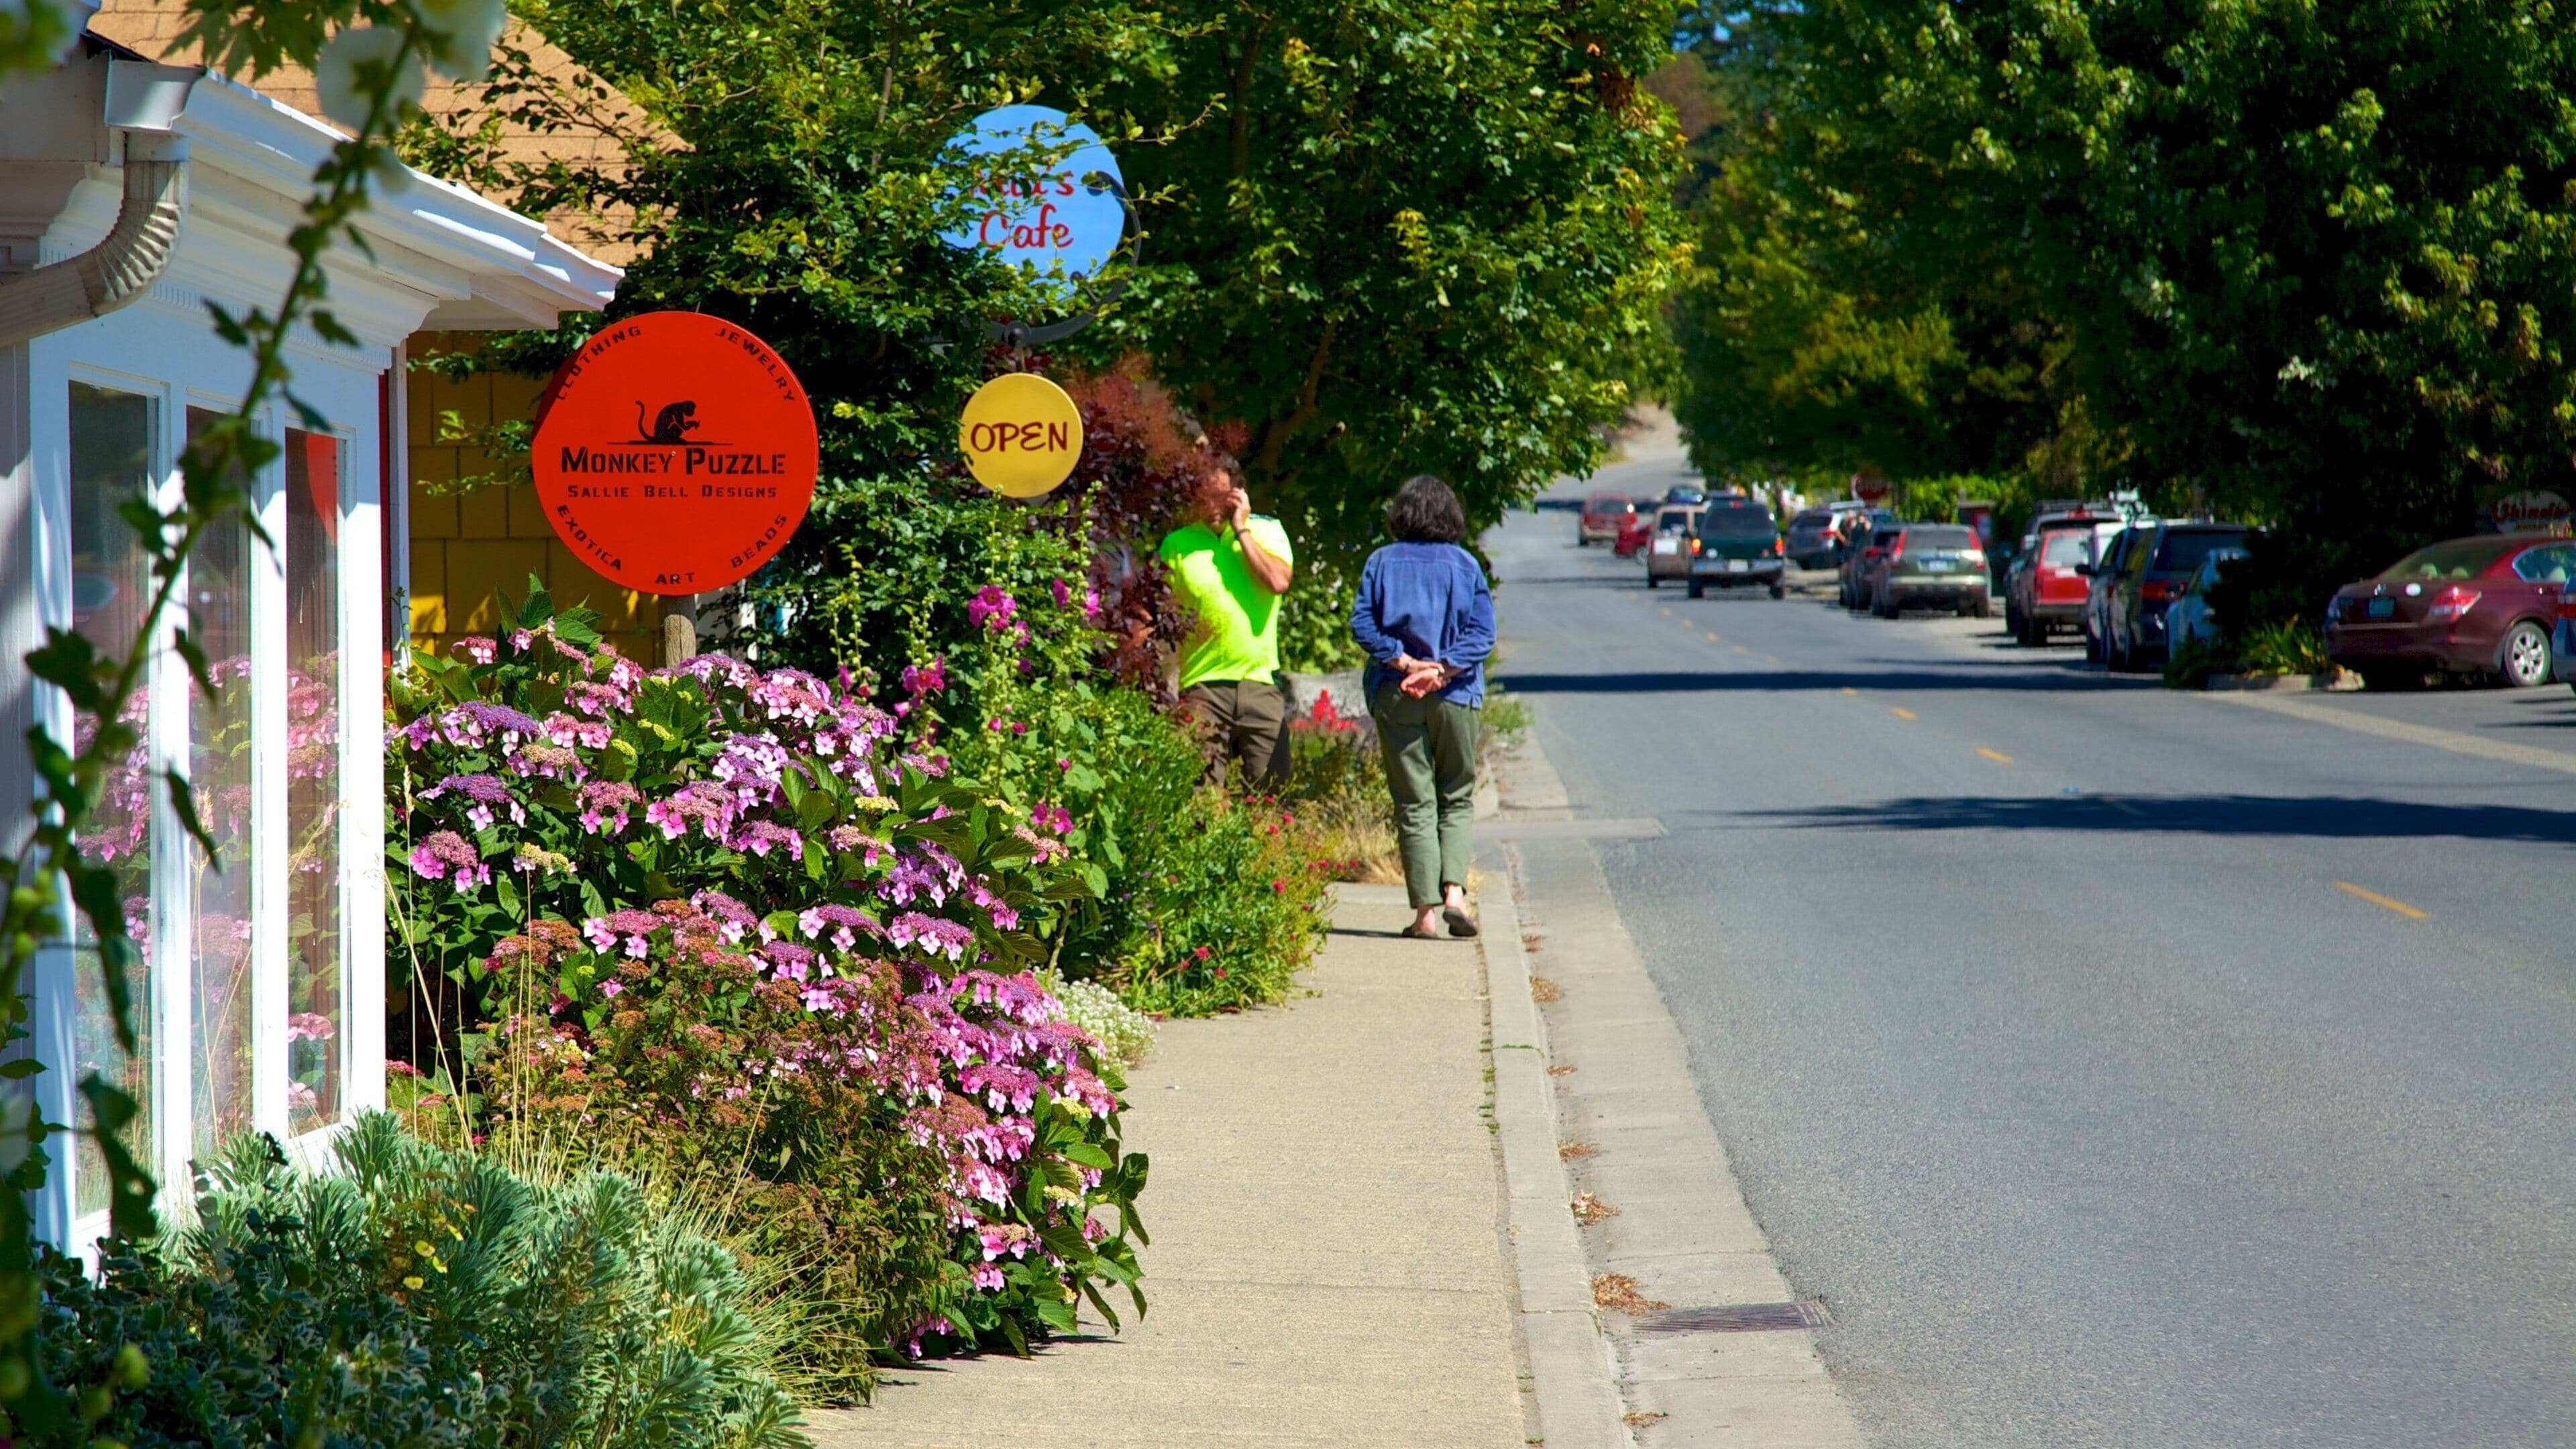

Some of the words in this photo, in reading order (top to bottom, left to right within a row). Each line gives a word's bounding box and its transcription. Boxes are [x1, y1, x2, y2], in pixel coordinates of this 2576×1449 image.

[979, 203, 1073, 250] Cafe
[556, 326, 641, 400] CLOTHING
[715, 327, 795, 402] JEWELRY
[971, 421, 1068, 452] OPEN
[561, 446, 674, 473] MONKEY
[686, 447, 786, 475] PUZZLE
[568, 485, 629, 498] SALLIE
[644, 485, 688, 498] BELL
[702, 484, 777, 498] DESIGNS
[556, 504, 623, 572] EXOTICA
[731, 514, 787, 568] BEADS
[655, 572, 695, 585] ART
